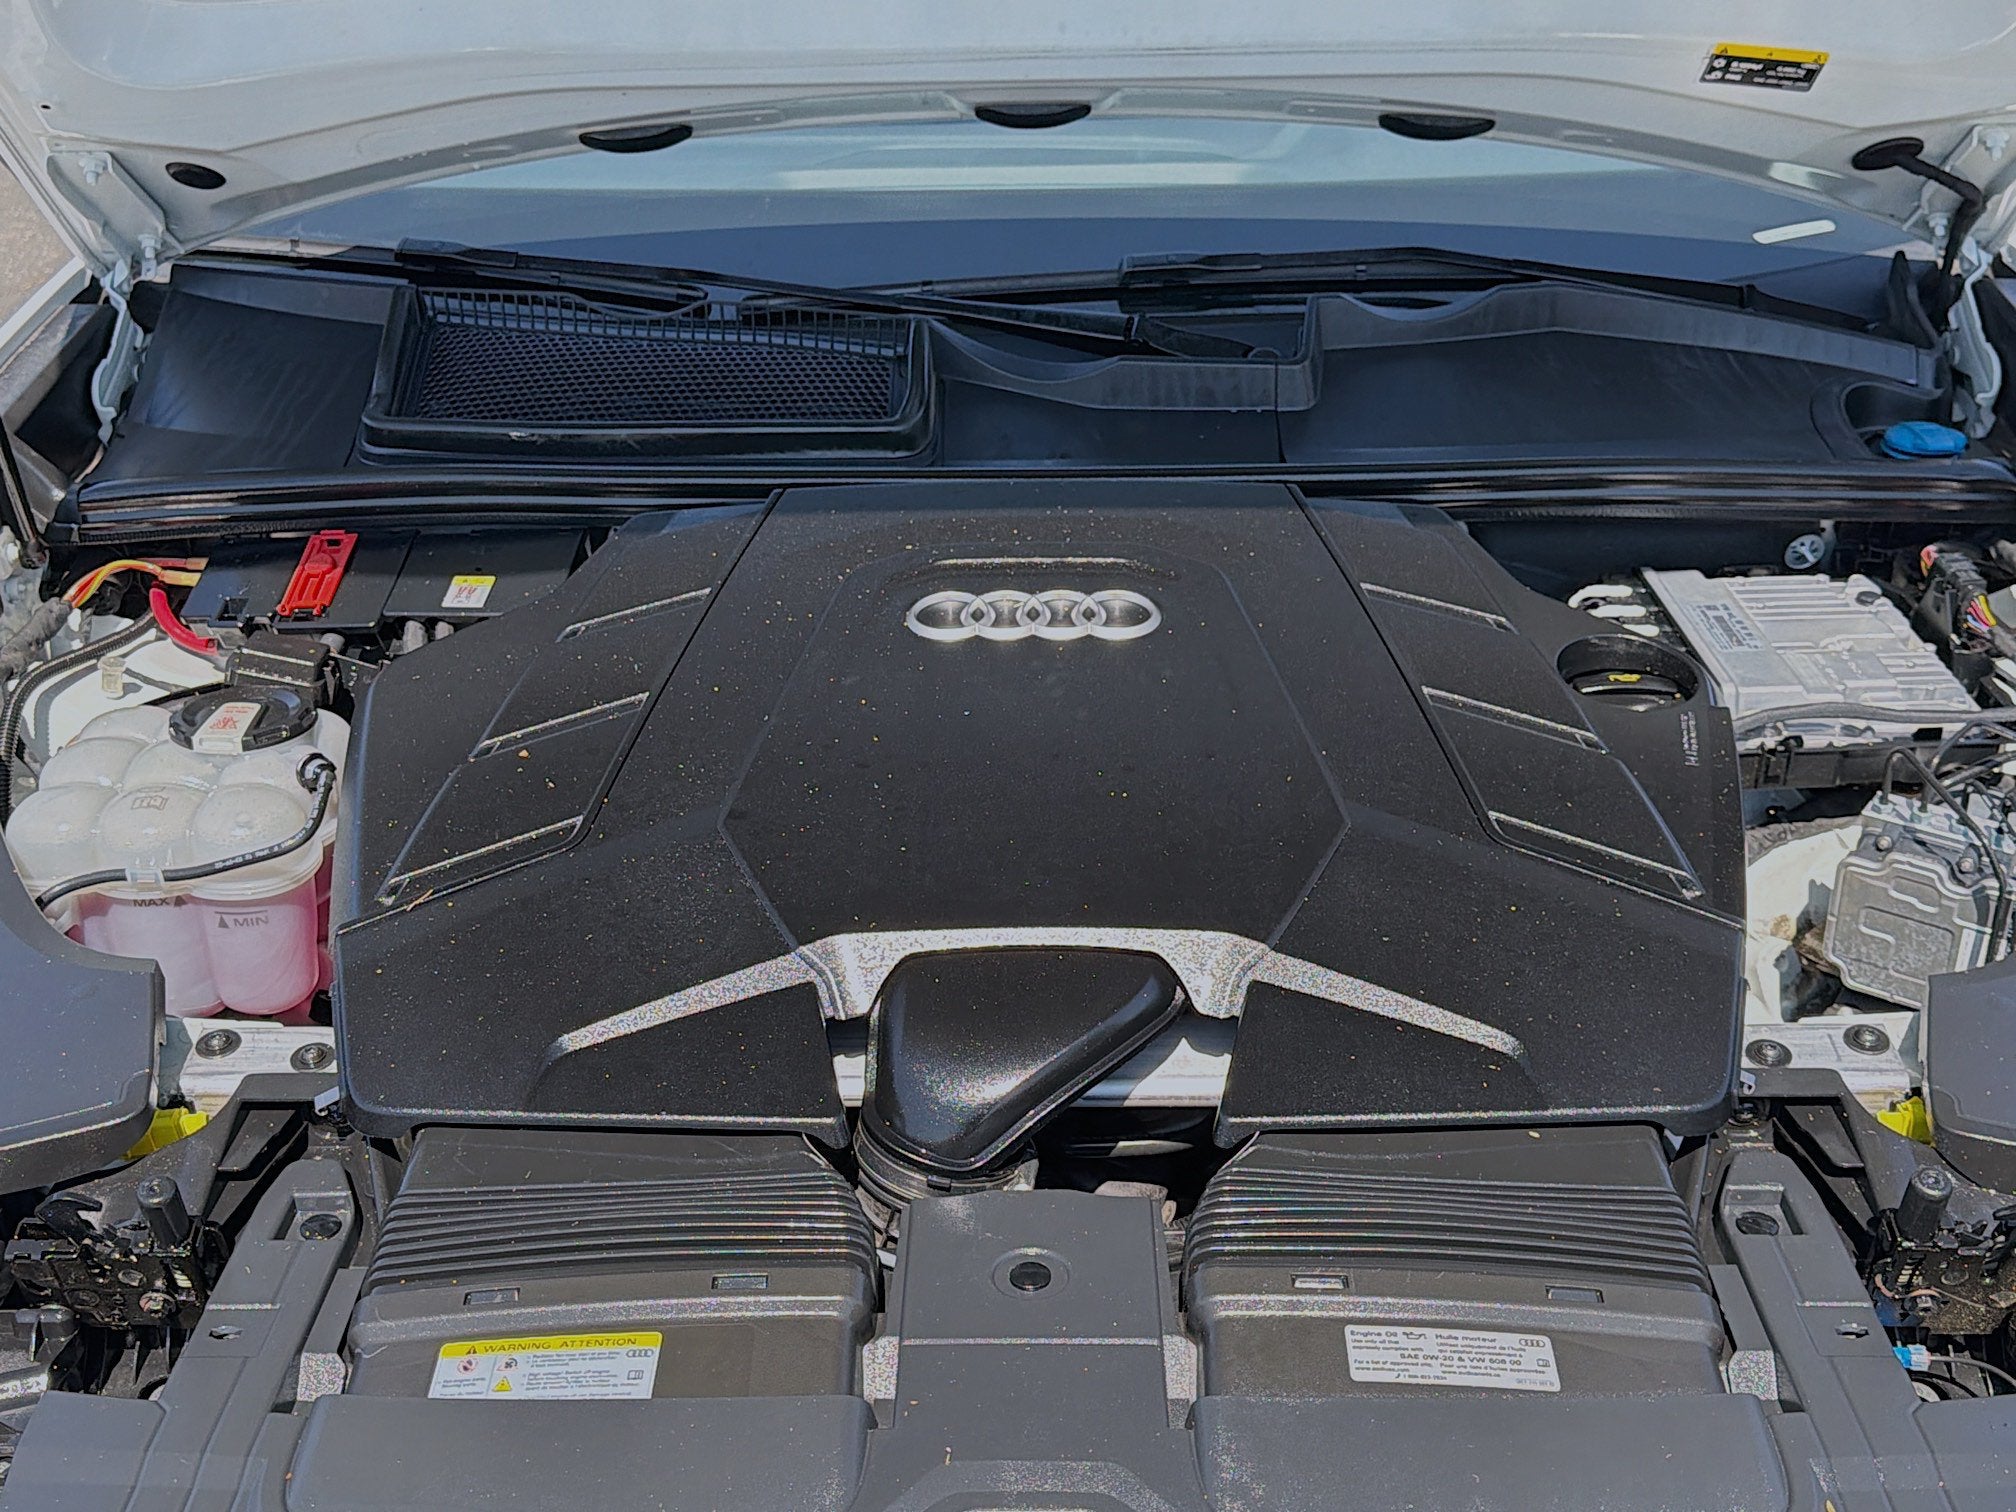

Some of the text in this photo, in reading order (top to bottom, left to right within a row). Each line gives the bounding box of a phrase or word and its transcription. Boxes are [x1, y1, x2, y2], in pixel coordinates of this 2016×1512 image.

[133, 898, 169, 907] MAX
[234, 916, 269, 927] MIN
[484, 1338, 637, 1353] WARNING ATTENTION
